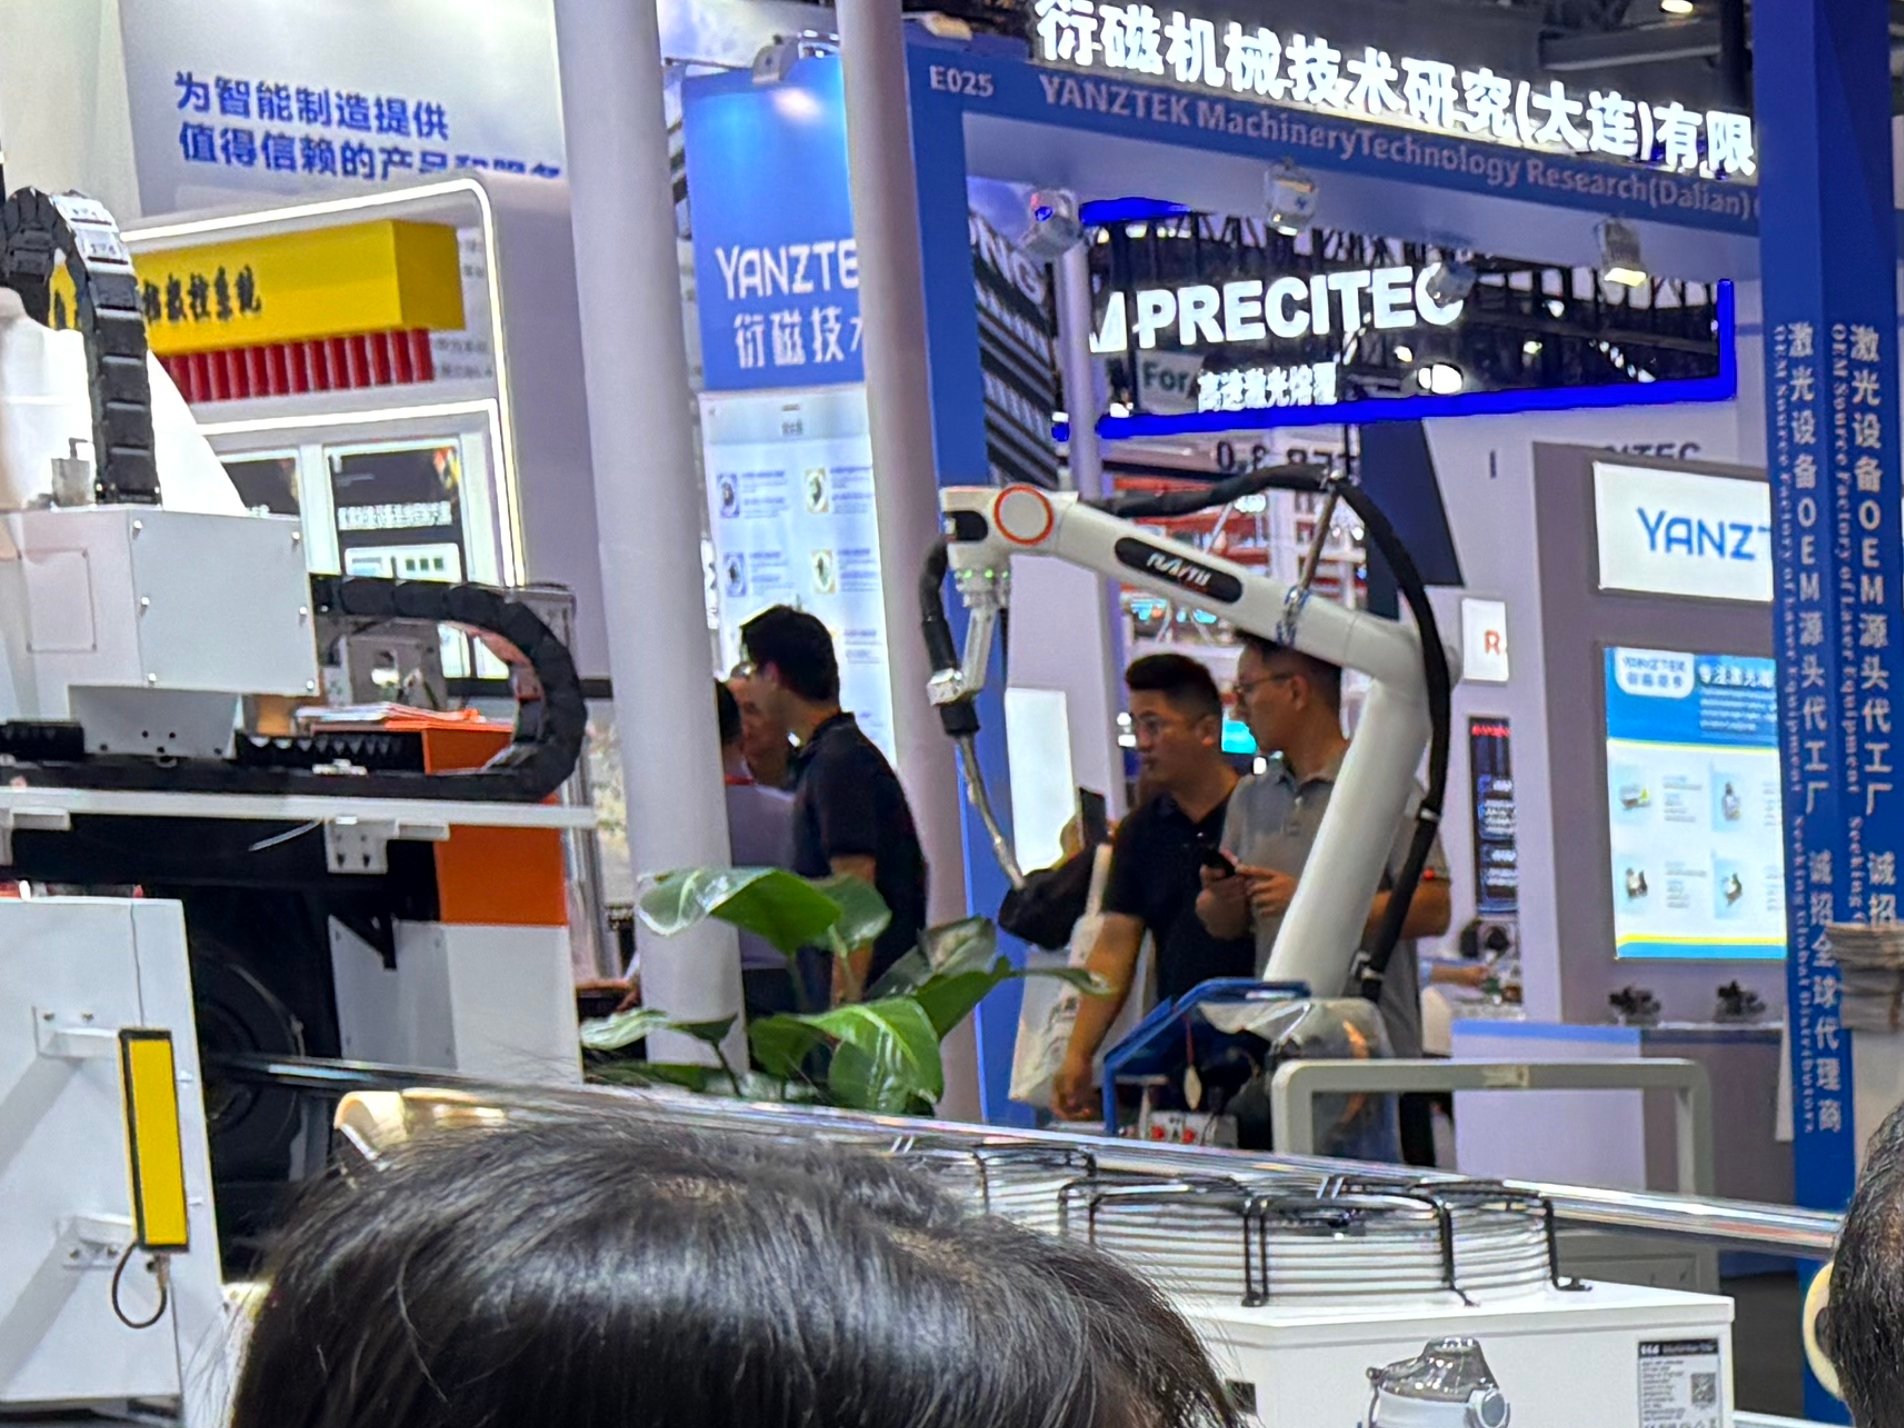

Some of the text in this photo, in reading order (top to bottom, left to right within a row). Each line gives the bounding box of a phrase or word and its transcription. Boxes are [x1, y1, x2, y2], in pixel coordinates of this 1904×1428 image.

[175, 71, 450, 142] 为智能制造提供
[928, 64, 994, 98] E025
[1039, 73, 1191, 127] YANZTEK
[1134, 261, 1465, 350] PRECITEC
[1636, 506, 1772, 562] YANZ
